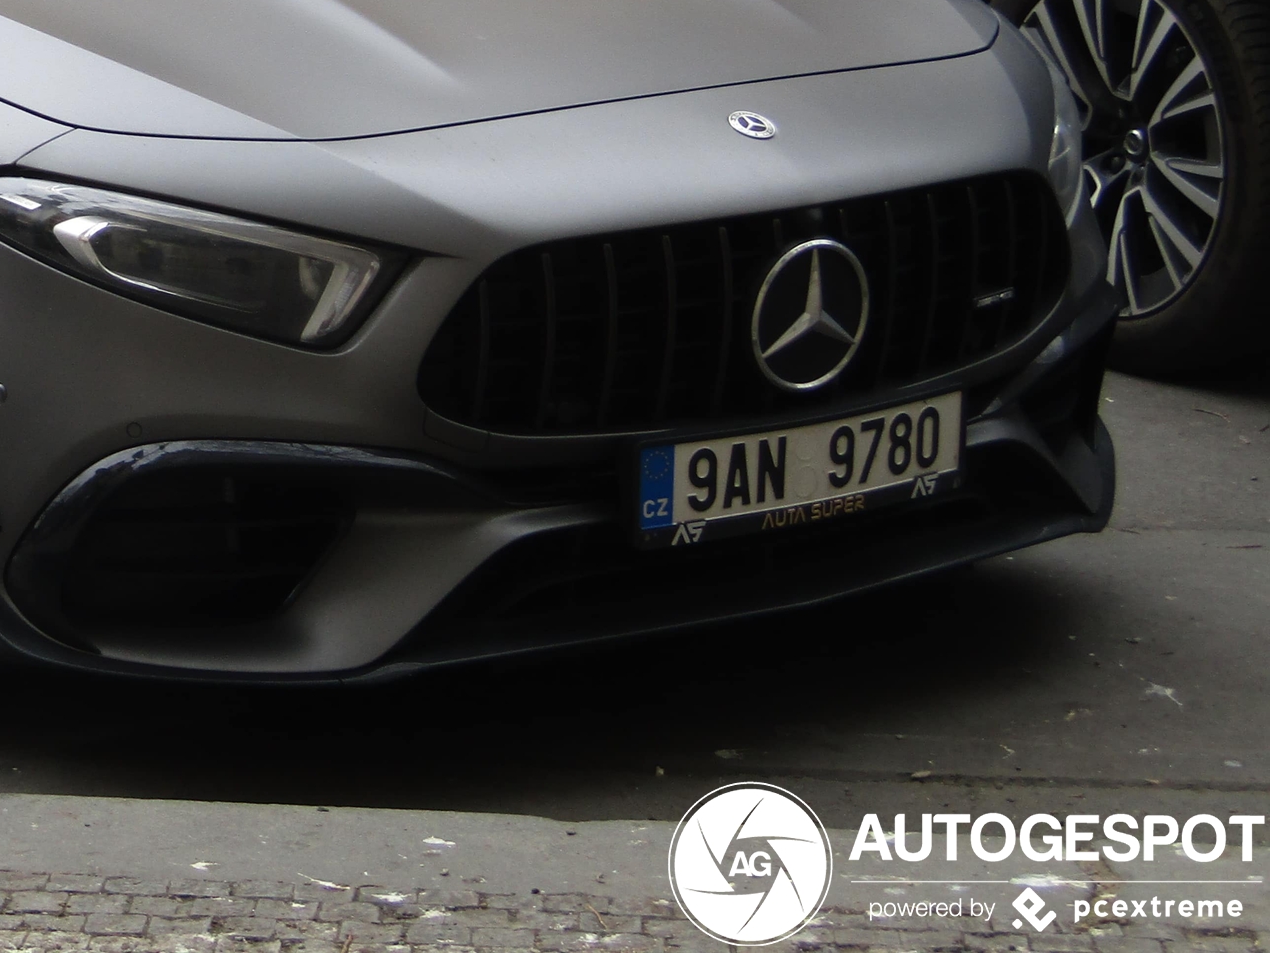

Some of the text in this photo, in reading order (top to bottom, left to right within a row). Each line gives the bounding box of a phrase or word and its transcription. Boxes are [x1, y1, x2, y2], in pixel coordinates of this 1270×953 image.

[687, 405, 941, 513] 9AN 9780
[642, 497, 670, 520] CZ
[761, 494, 866, 531] AUTA SUPER
